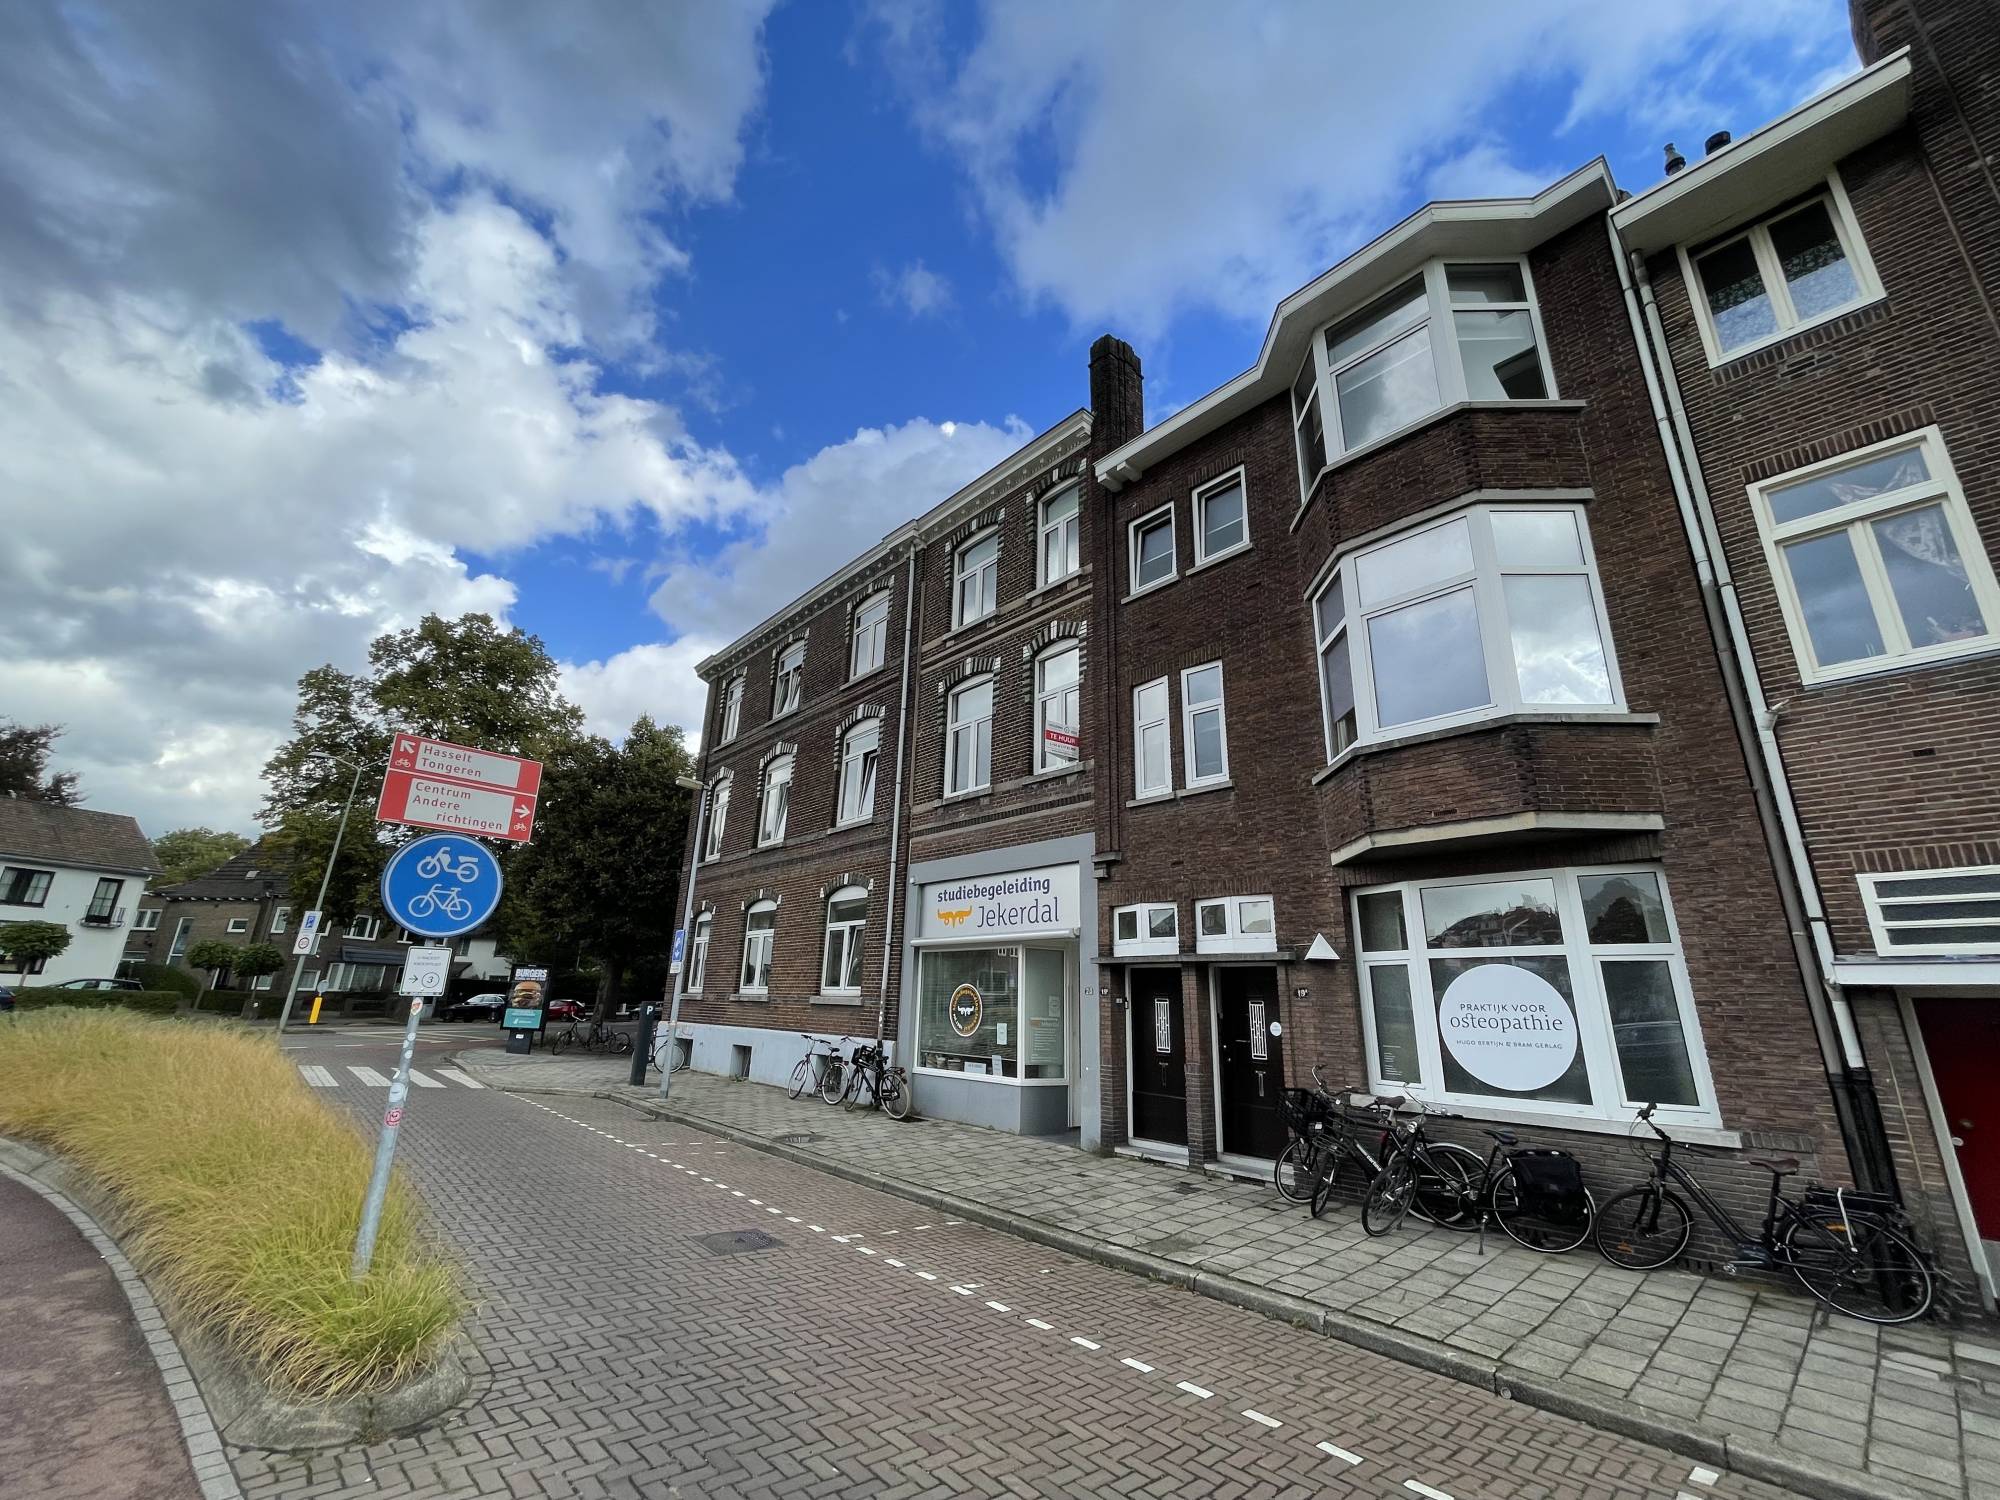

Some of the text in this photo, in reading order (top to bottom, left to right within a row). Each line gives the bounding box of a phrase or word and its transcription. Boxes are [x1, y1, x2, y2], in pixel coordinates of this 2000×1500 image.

[1050, 732, 1076, 744] TE HUUR
[423, 745, 472, 763] Hasselt
[422, 757, 482, 777] Tongeren
[415, 782, 471, 800] Centrum
[412, 794, 460, 811] Andere
[436, 811, 502, 831] richtingen
[937, 876, 1051, 902] studiebegeleiding
[976, 896, 1060, 928] Jekerdal
[426, 975, 434, 984] 3
[515, 968, 547, 978] BURGERS
[646, 1005, 653, 1015] P
[1460, 1003, 1546, 1014] PRAKTIJK VOOR
[1450, 1013, 1563, 1033] osteopathie
